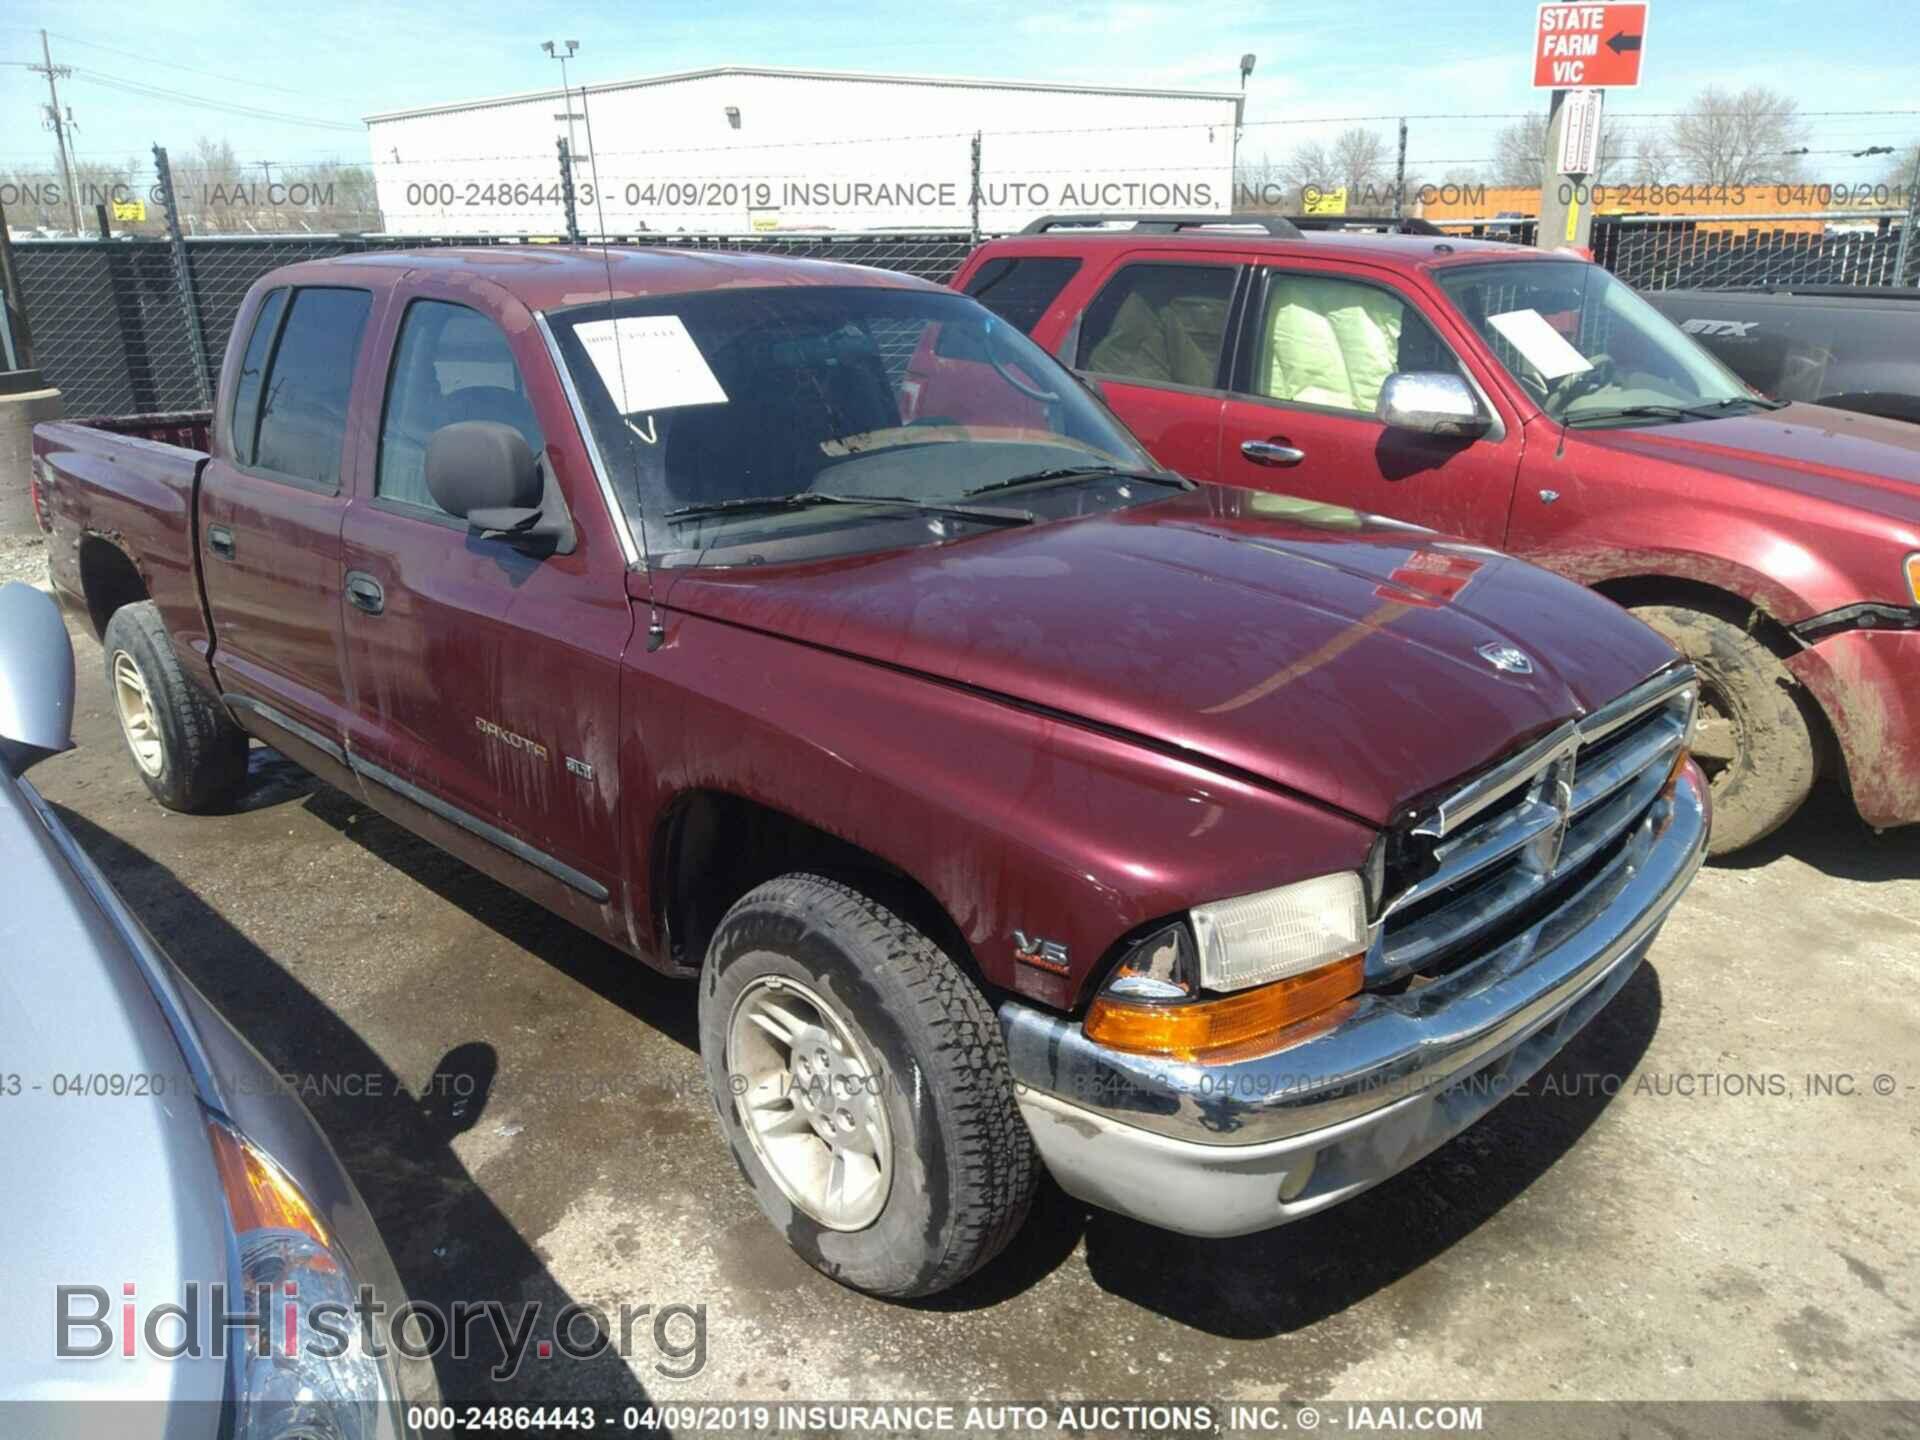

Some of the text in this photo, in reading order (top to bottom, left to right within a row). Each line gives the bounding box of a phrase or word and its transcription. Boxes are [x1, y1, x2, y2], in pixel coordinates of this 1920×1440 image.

[1541, 8, 1604, 31] STATE
[1543, 35, 1598, 57] FARM
[1552, 61, 1584, 83] VIC
